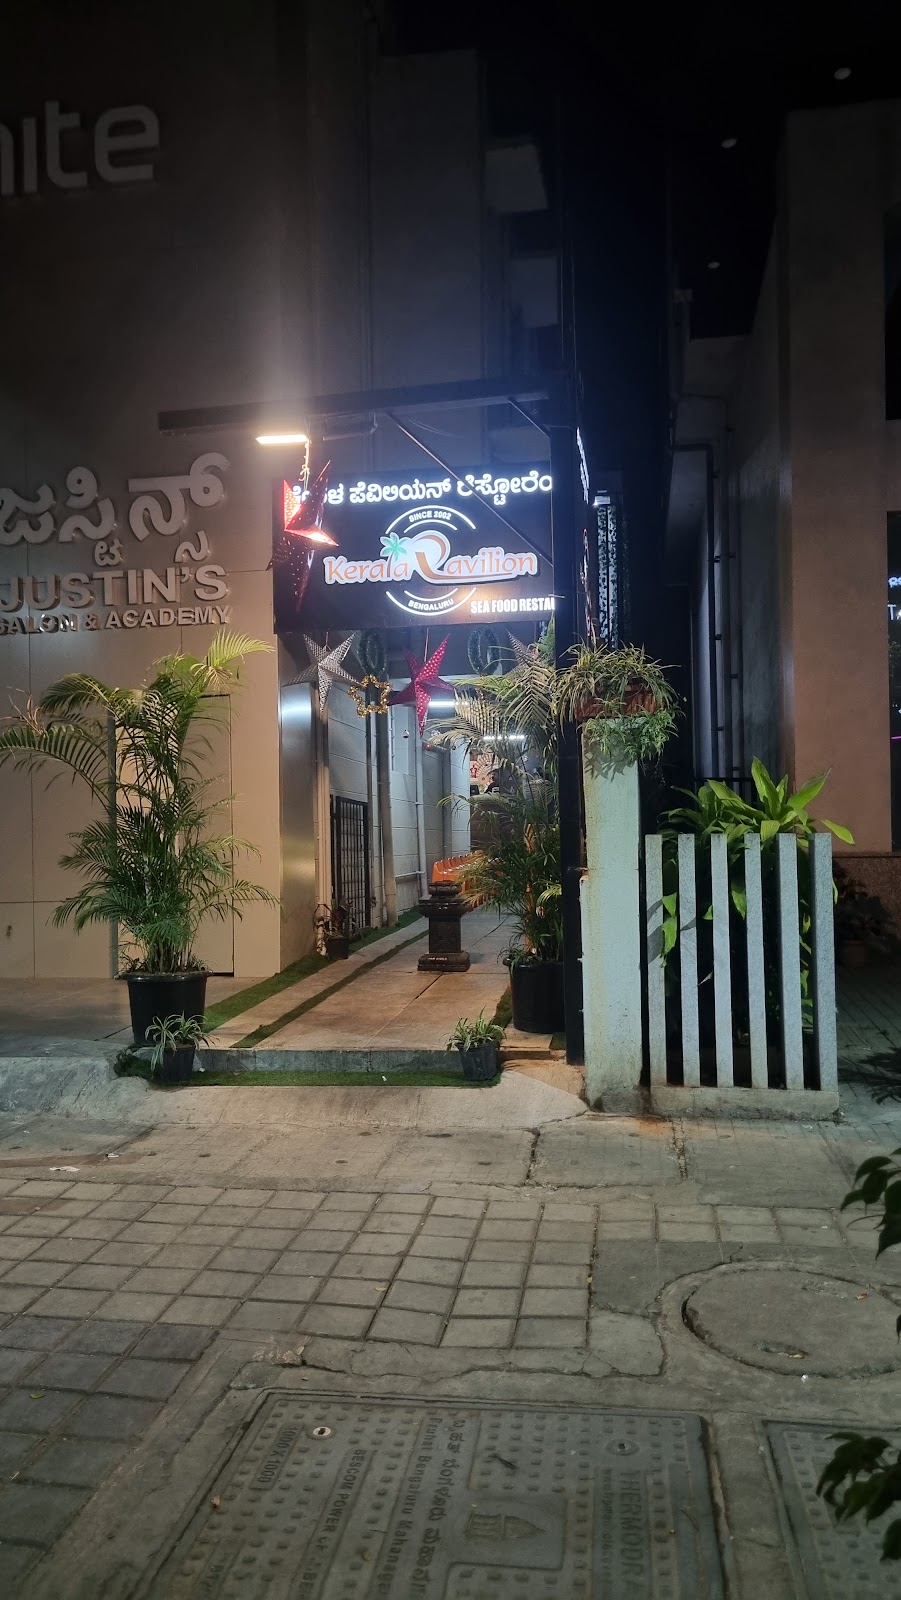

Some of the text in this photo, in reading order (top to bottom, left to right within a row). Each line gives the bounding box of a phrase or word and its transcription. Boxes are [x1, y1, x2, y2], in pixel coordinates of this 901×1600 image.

[0, 100, 160, 196] ite
[408, 510, 452, 523] SINCE 2002
[323, 545, 410, 585] Kerala
[0, 564, 229, 613] JUSTIN'S
[408, 598, 455, 612] BENGALURU
[470, 600, 491, 614] SEA
[491, 599, 518, 613] FOOD
[85, 613, 100, 631] &
[106, 606, 231, 629] ACADEMY
